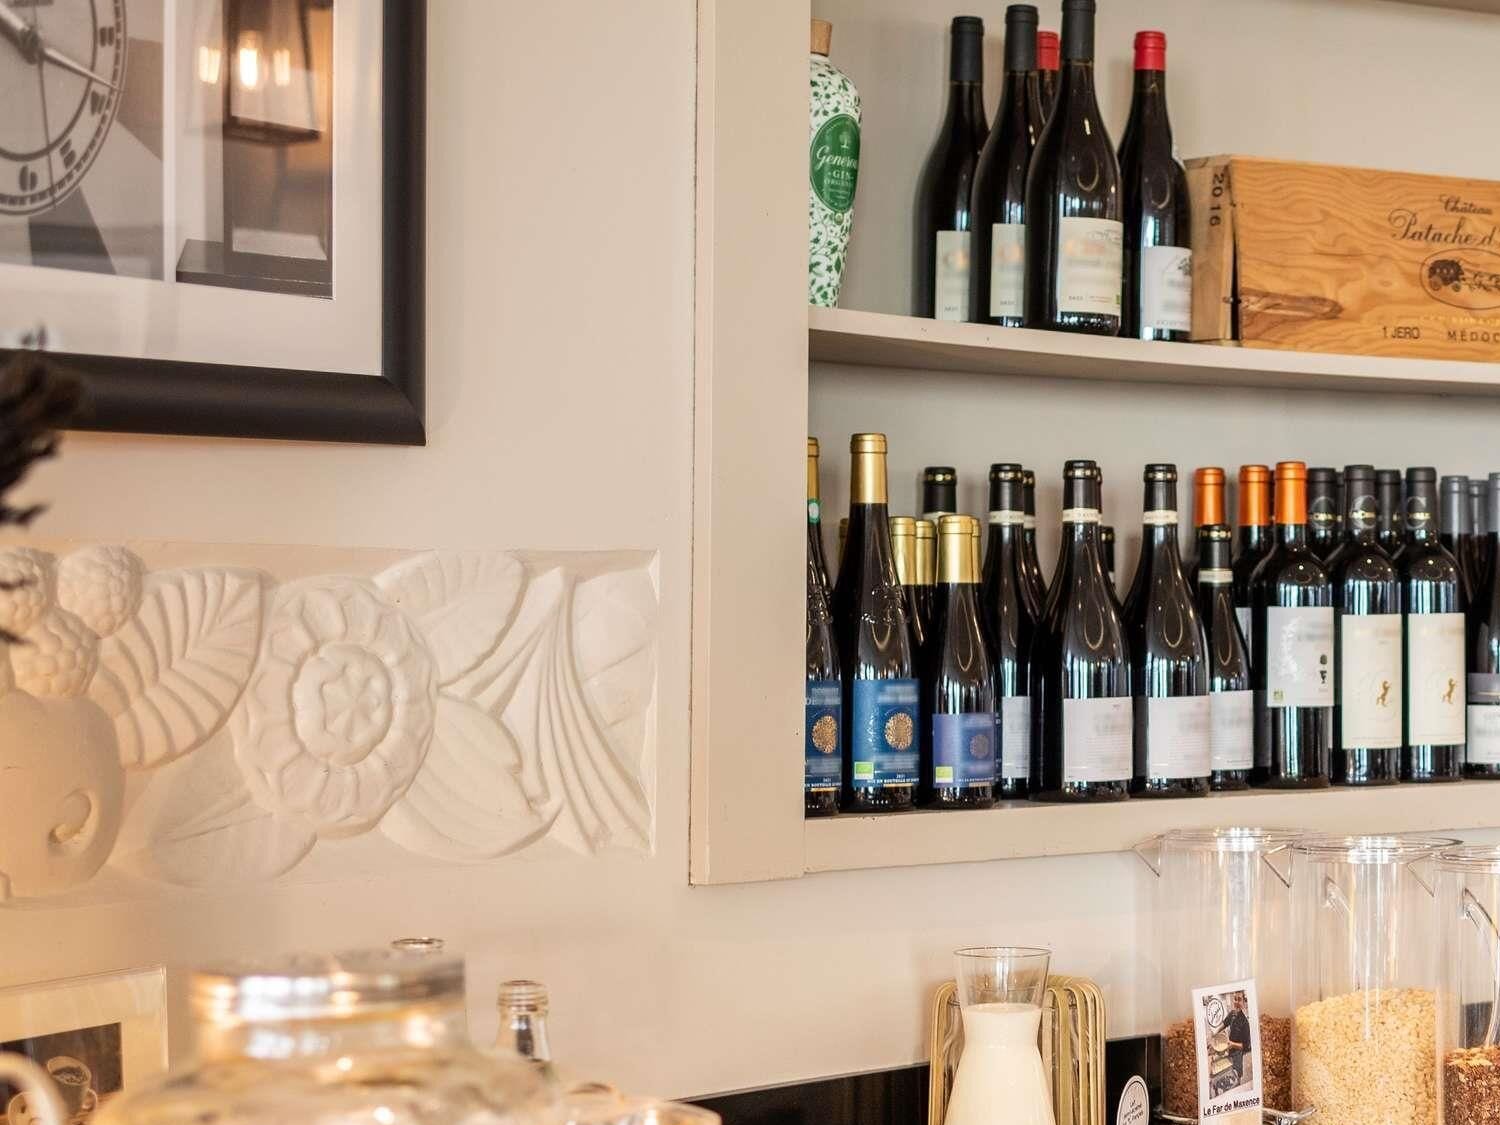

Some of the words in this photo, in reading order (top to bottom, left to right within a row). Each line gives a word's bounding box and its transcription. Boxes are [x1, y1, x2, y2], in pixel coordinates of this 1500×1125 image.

[1209, 172, 1225, 227] 2016
[1440, 193, 1493, 215] Château
[1388, 208, 1474, 244] Patache
[1391, 326, 1421, 340] JERO
[1203, 1107, 1212, 1116] Le
[1212, 1104, 1224, 1114] Far
[1224, 1101, 1233, 1111] de
[1233, 1096, 1260, 1109] Maxence
